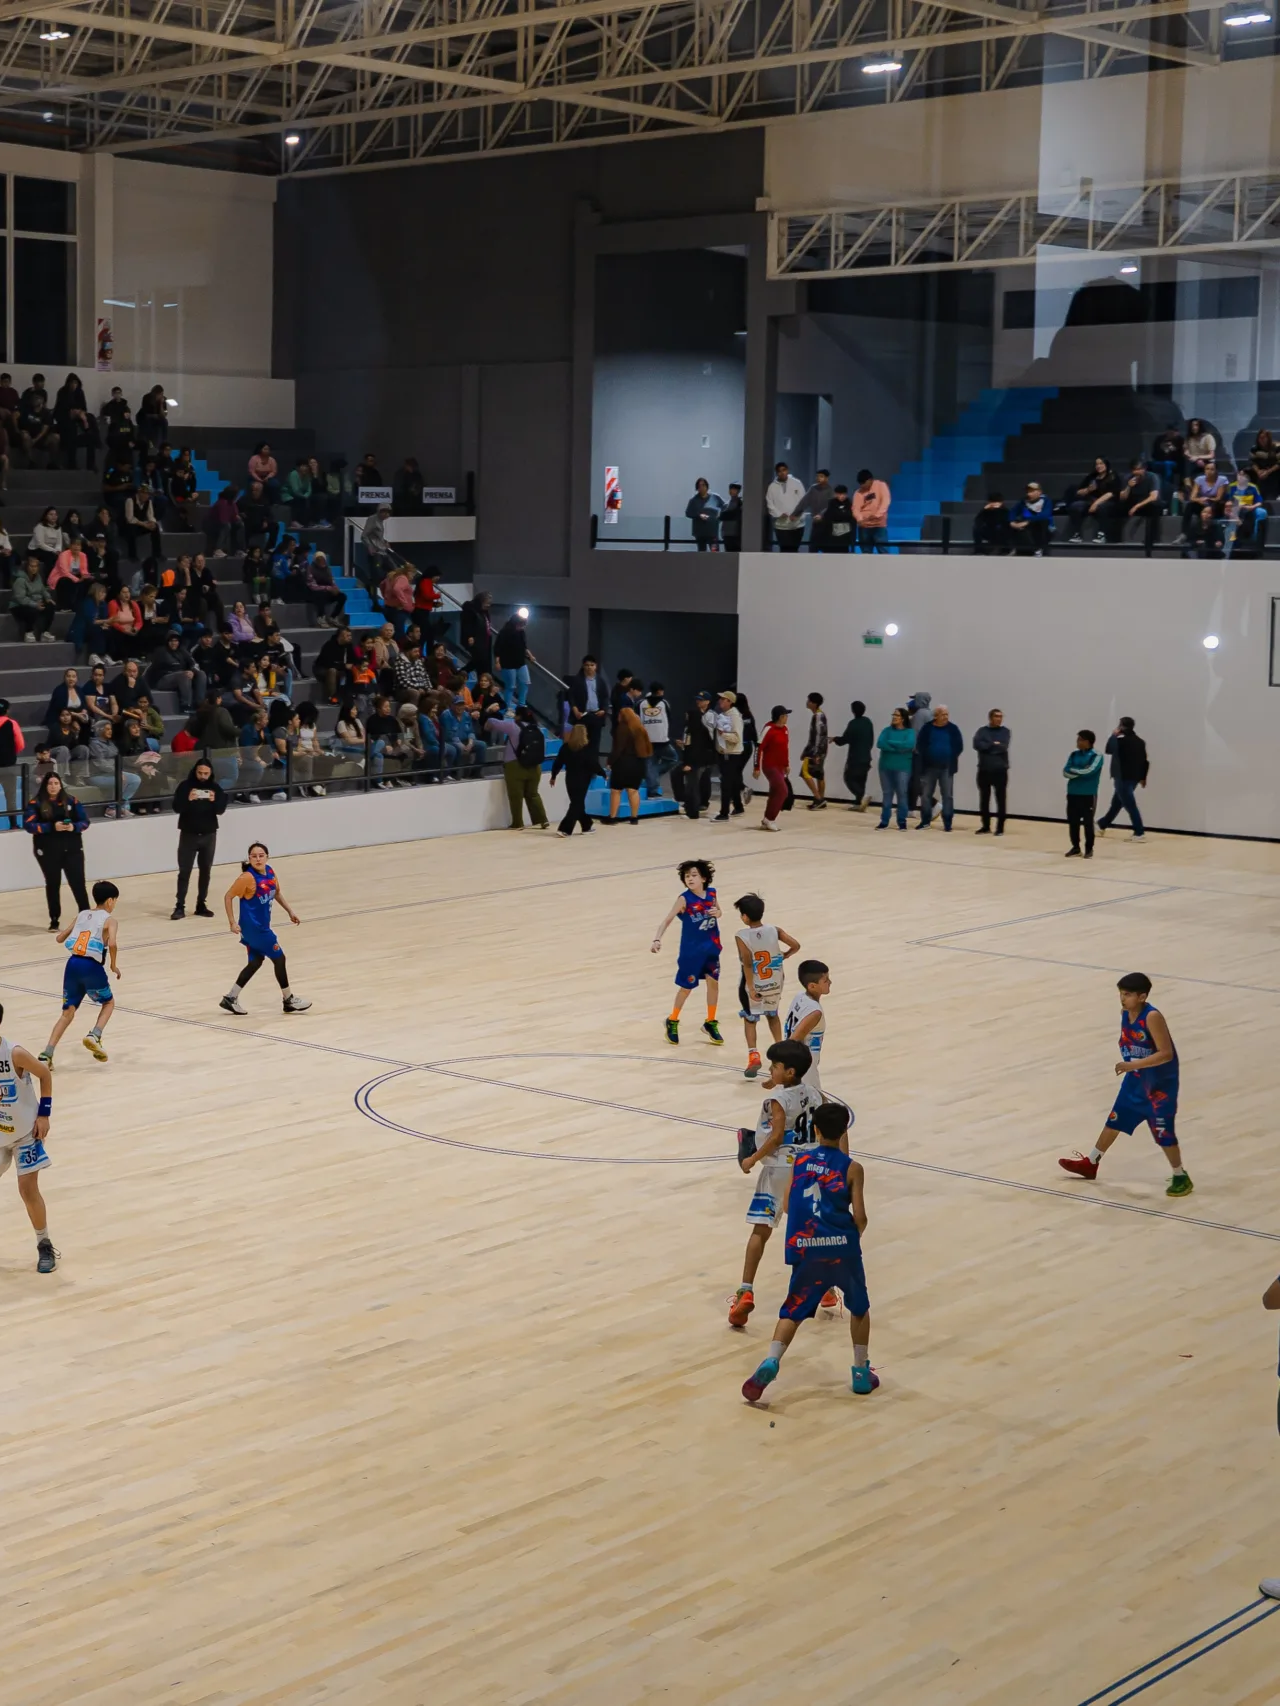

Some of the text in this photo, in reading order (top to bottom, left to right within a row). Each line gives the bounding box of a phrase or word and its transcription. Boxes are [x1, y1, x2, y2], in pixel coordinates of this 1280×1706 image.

[360, 491, 391, 499] PRENSA
[424, 491, 454, 499] PRENSA
[73, 930, 91, 956] 8
[753, 950, 773, 980] 2
[25, 1149, 39, 1164] 35
[796, 1235, 848, 1248] CATAMARCA
